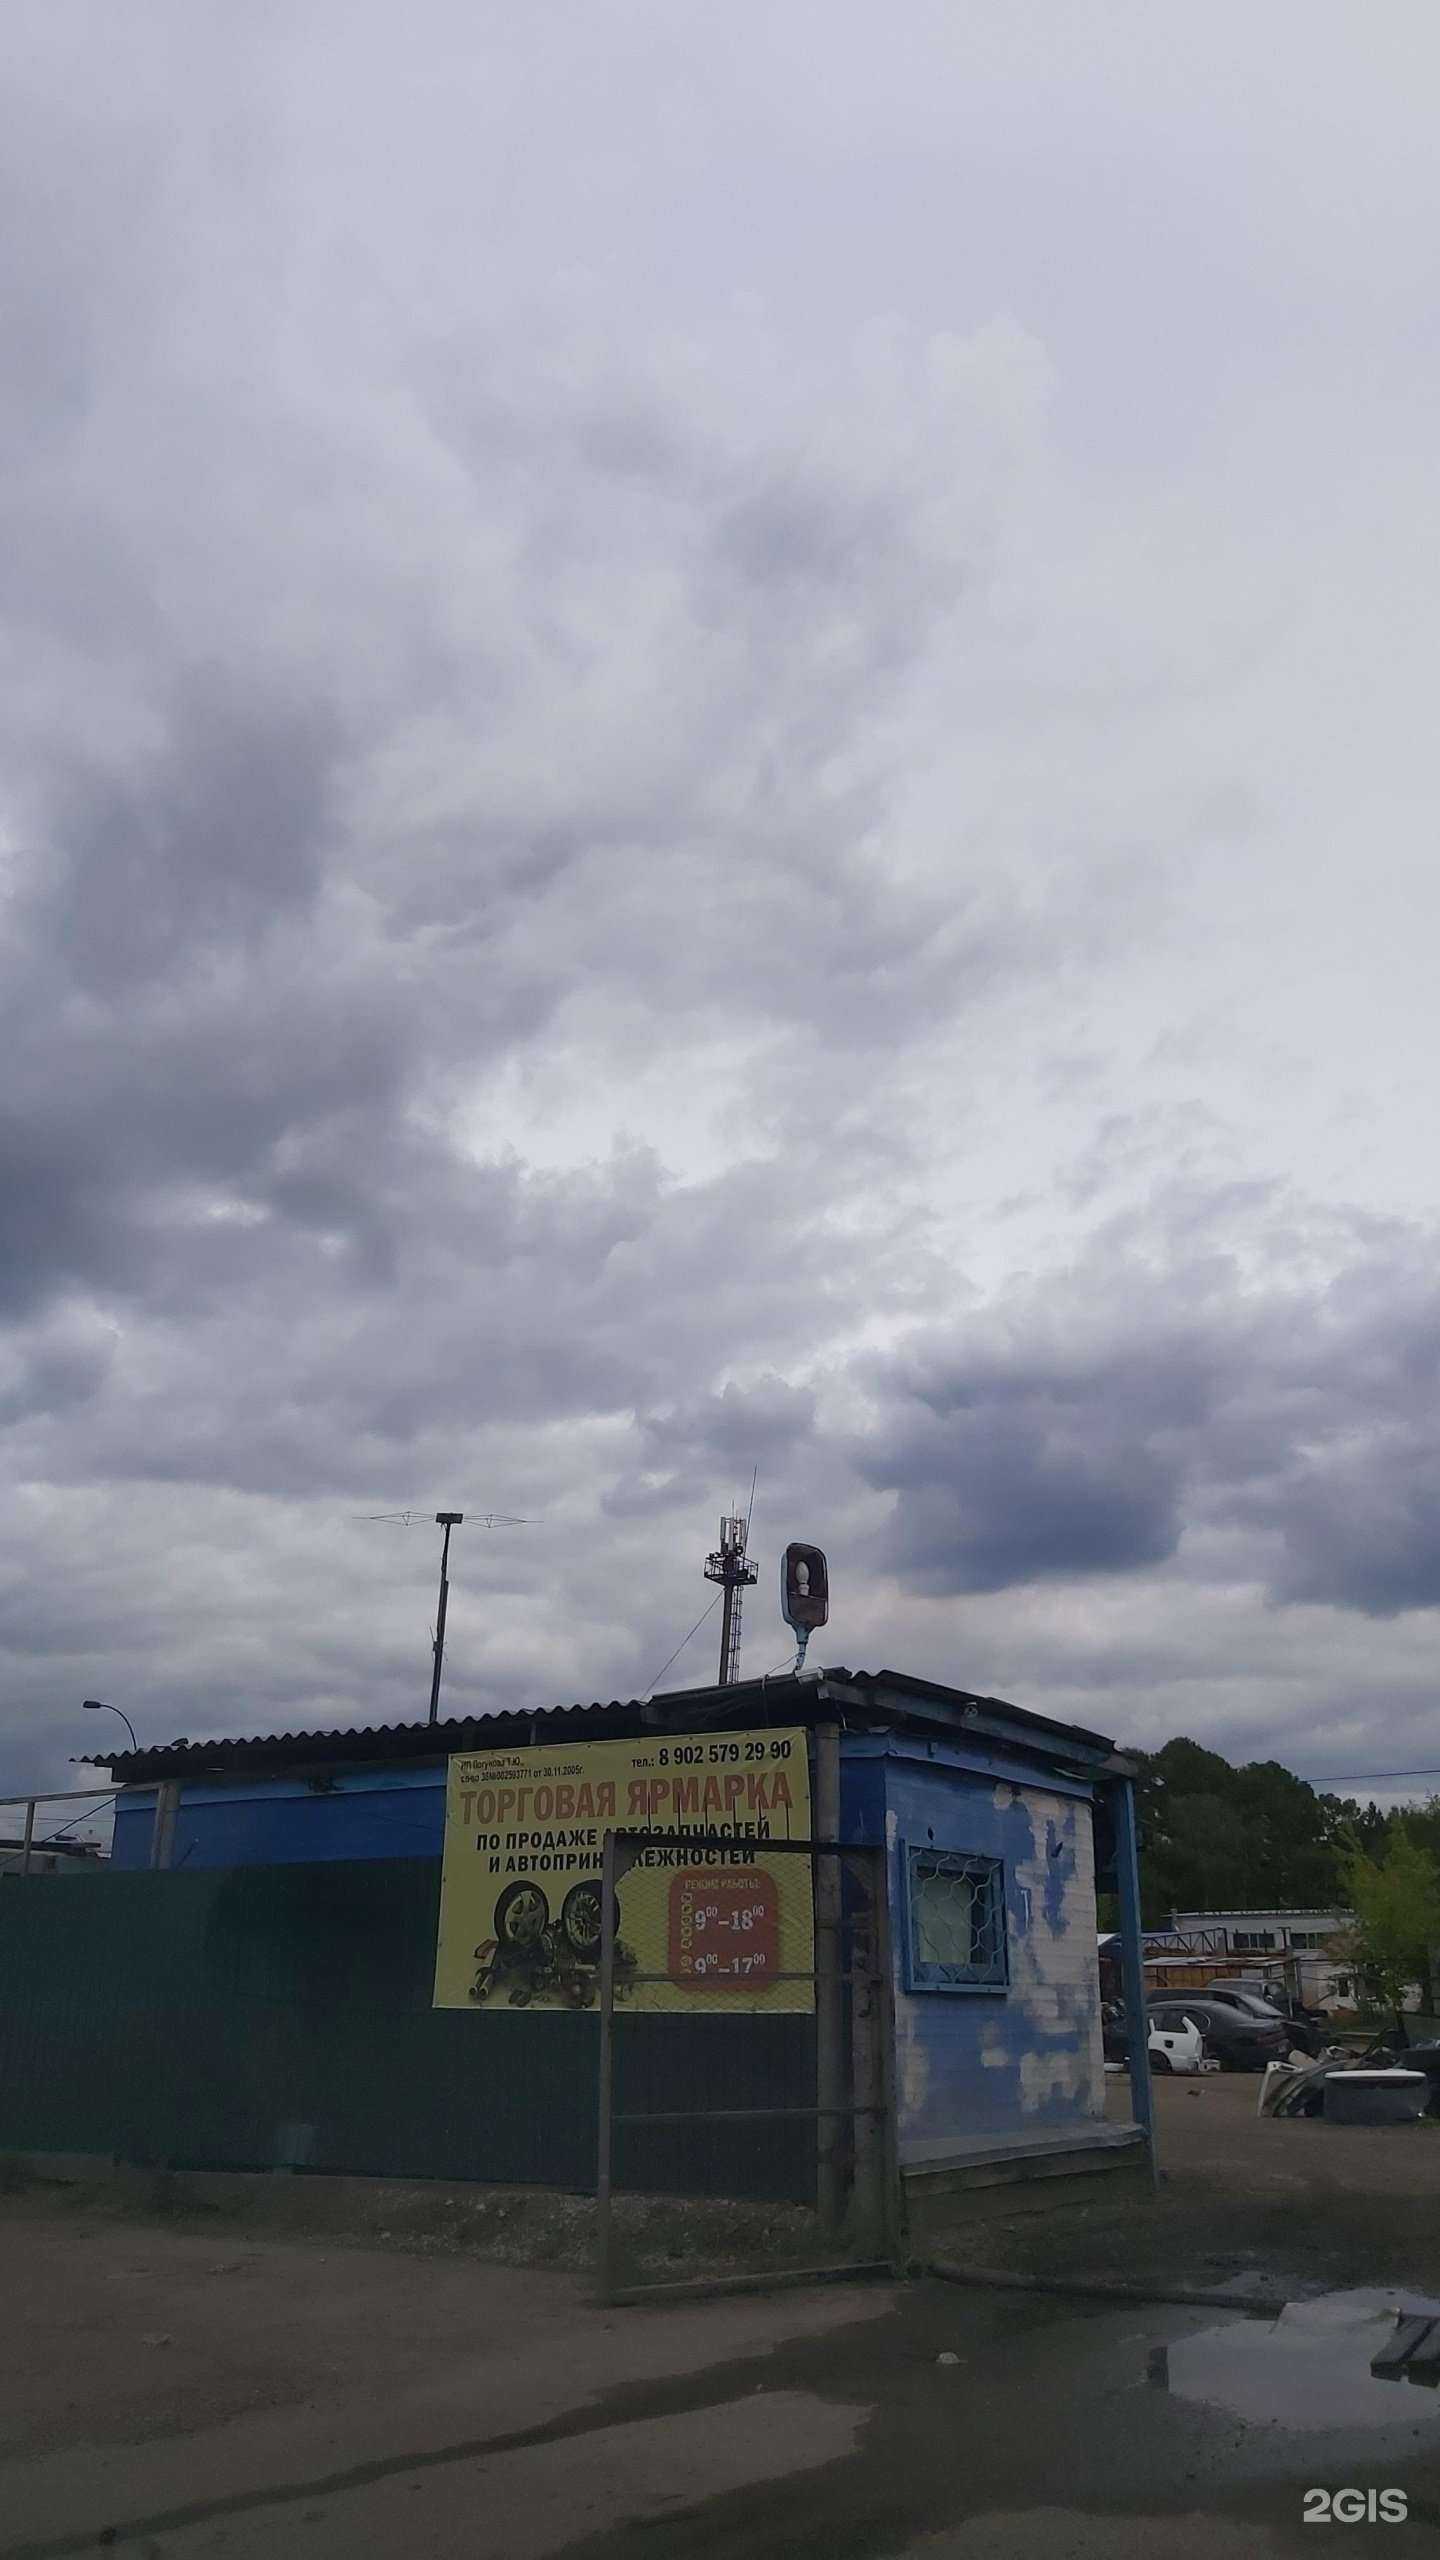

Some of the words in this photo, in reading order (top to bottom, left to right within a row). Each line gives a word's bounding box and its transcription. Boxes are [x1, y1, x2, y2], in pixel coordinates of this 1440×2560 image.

[631, 1757, 655, 1768] тел.:
[659, 1748, 669, 1766] 8
[674, 1746, 704, 1765] 902
[709, 1744, 739, 1763] 579
[745, 1742, 765, 1761] 29
[770, 1740, 792, 1759] 90
[459, 1782, 616, 1825] ТОРГОВАЯ
[627, 1771, 793, 1816] ЯРМАРКА
[477, 1833, 501, 1851] ПО
[505, 1829, 598, 1851] ПРОДАЖЕ
[489, 1856, 500, 1873] И
